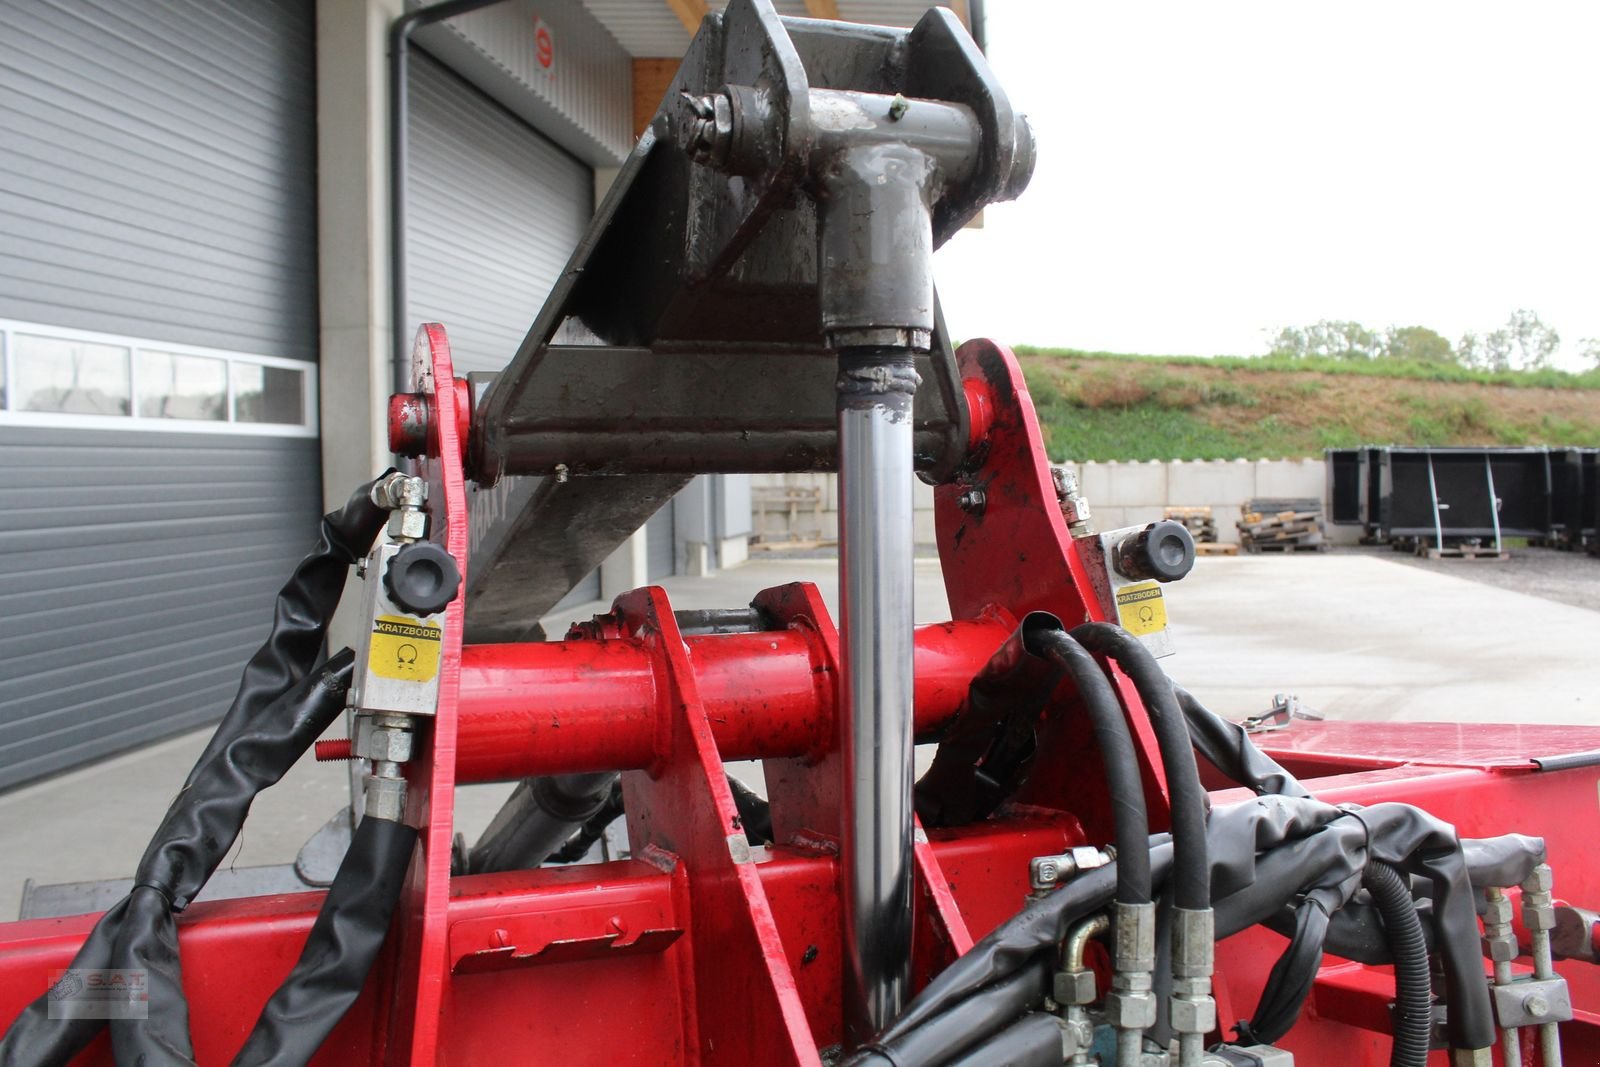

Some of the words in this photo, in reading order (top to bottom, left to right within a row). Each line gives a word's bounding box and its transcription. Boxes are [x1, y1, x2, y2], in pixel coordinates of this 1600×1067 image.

[535, 28, 553, 69] 9
[1117, 589, 1161, 603] KRATZBODEN
[377, 623, 441, 638] KRATZBODEN
